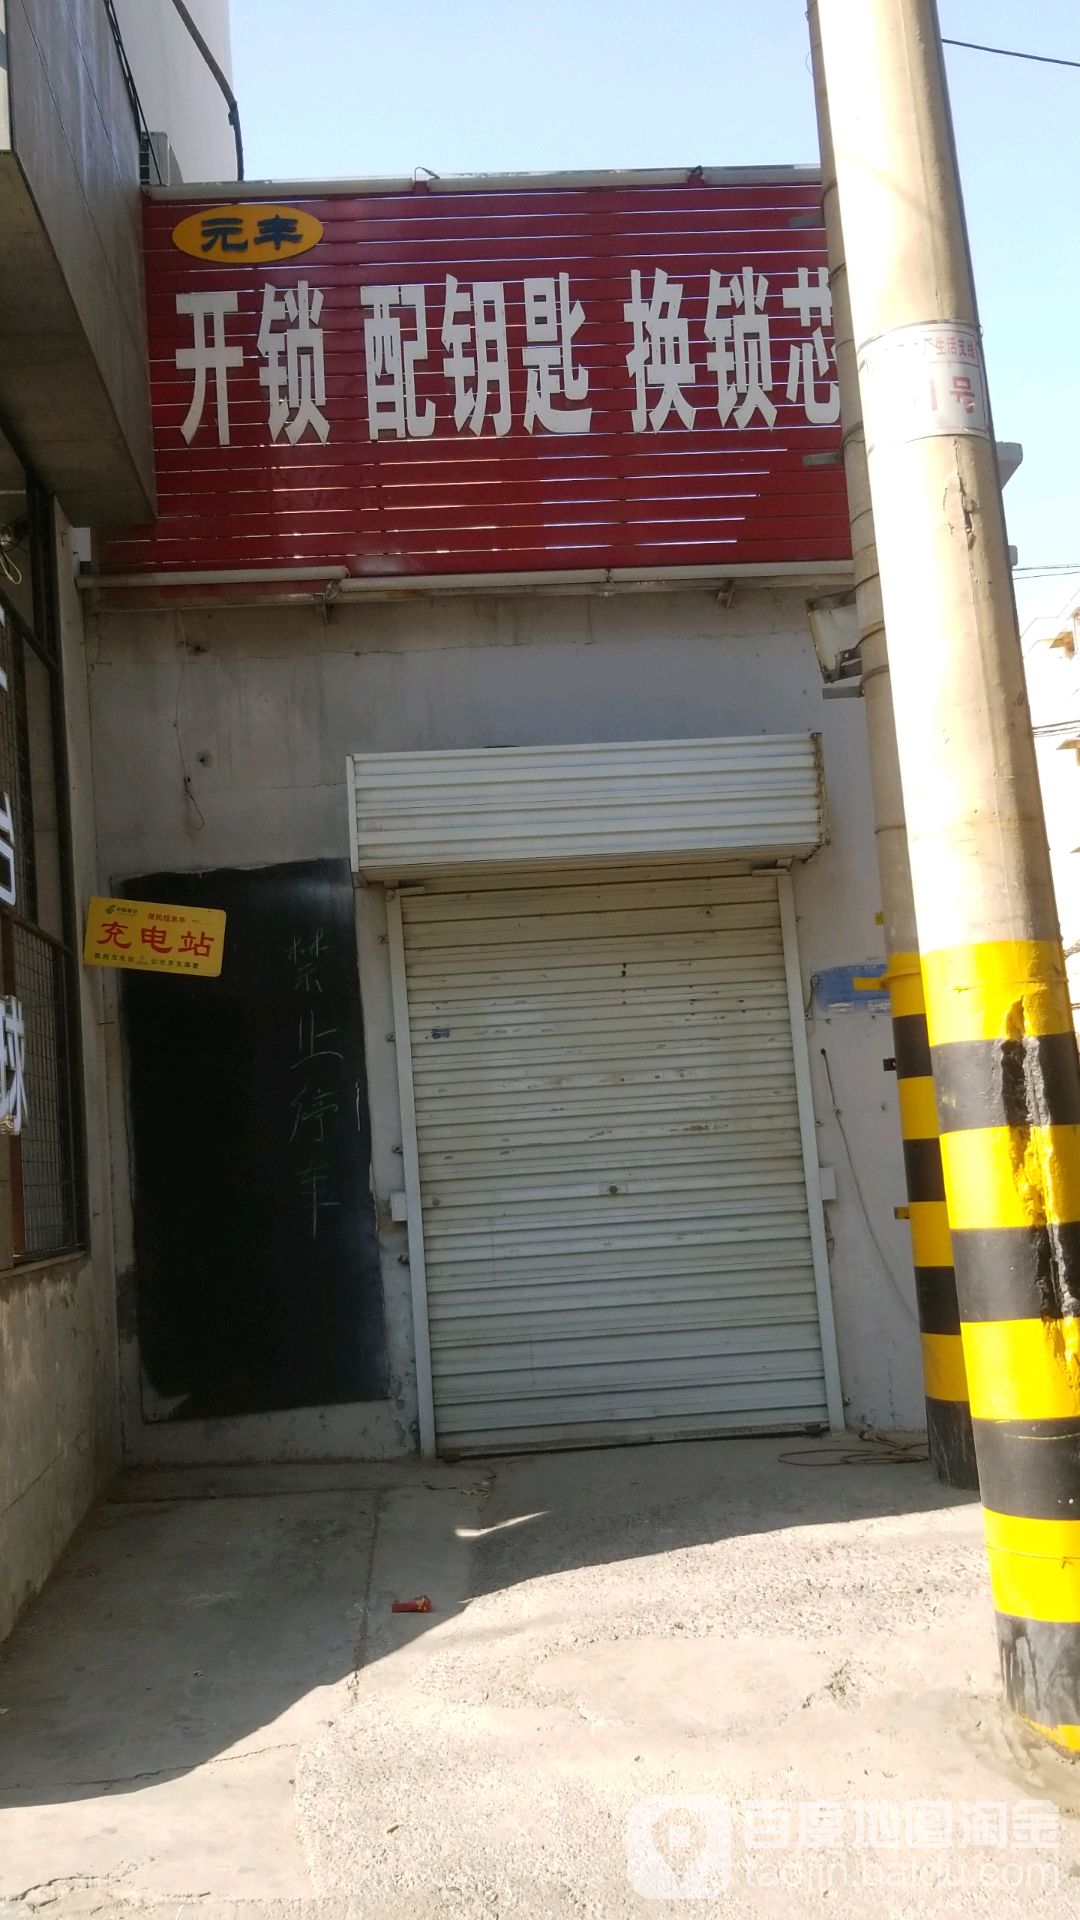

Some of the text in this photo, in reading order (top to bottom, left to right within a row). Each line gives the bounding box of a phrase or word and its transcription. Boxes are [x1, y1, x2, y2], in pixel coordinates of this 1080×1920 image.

[201, 213, 303, 252] 元丰
[175, 267, 841, 447] 开锁 配钥匙 换锁芯
[96, 920, 215, 957] 充电站
